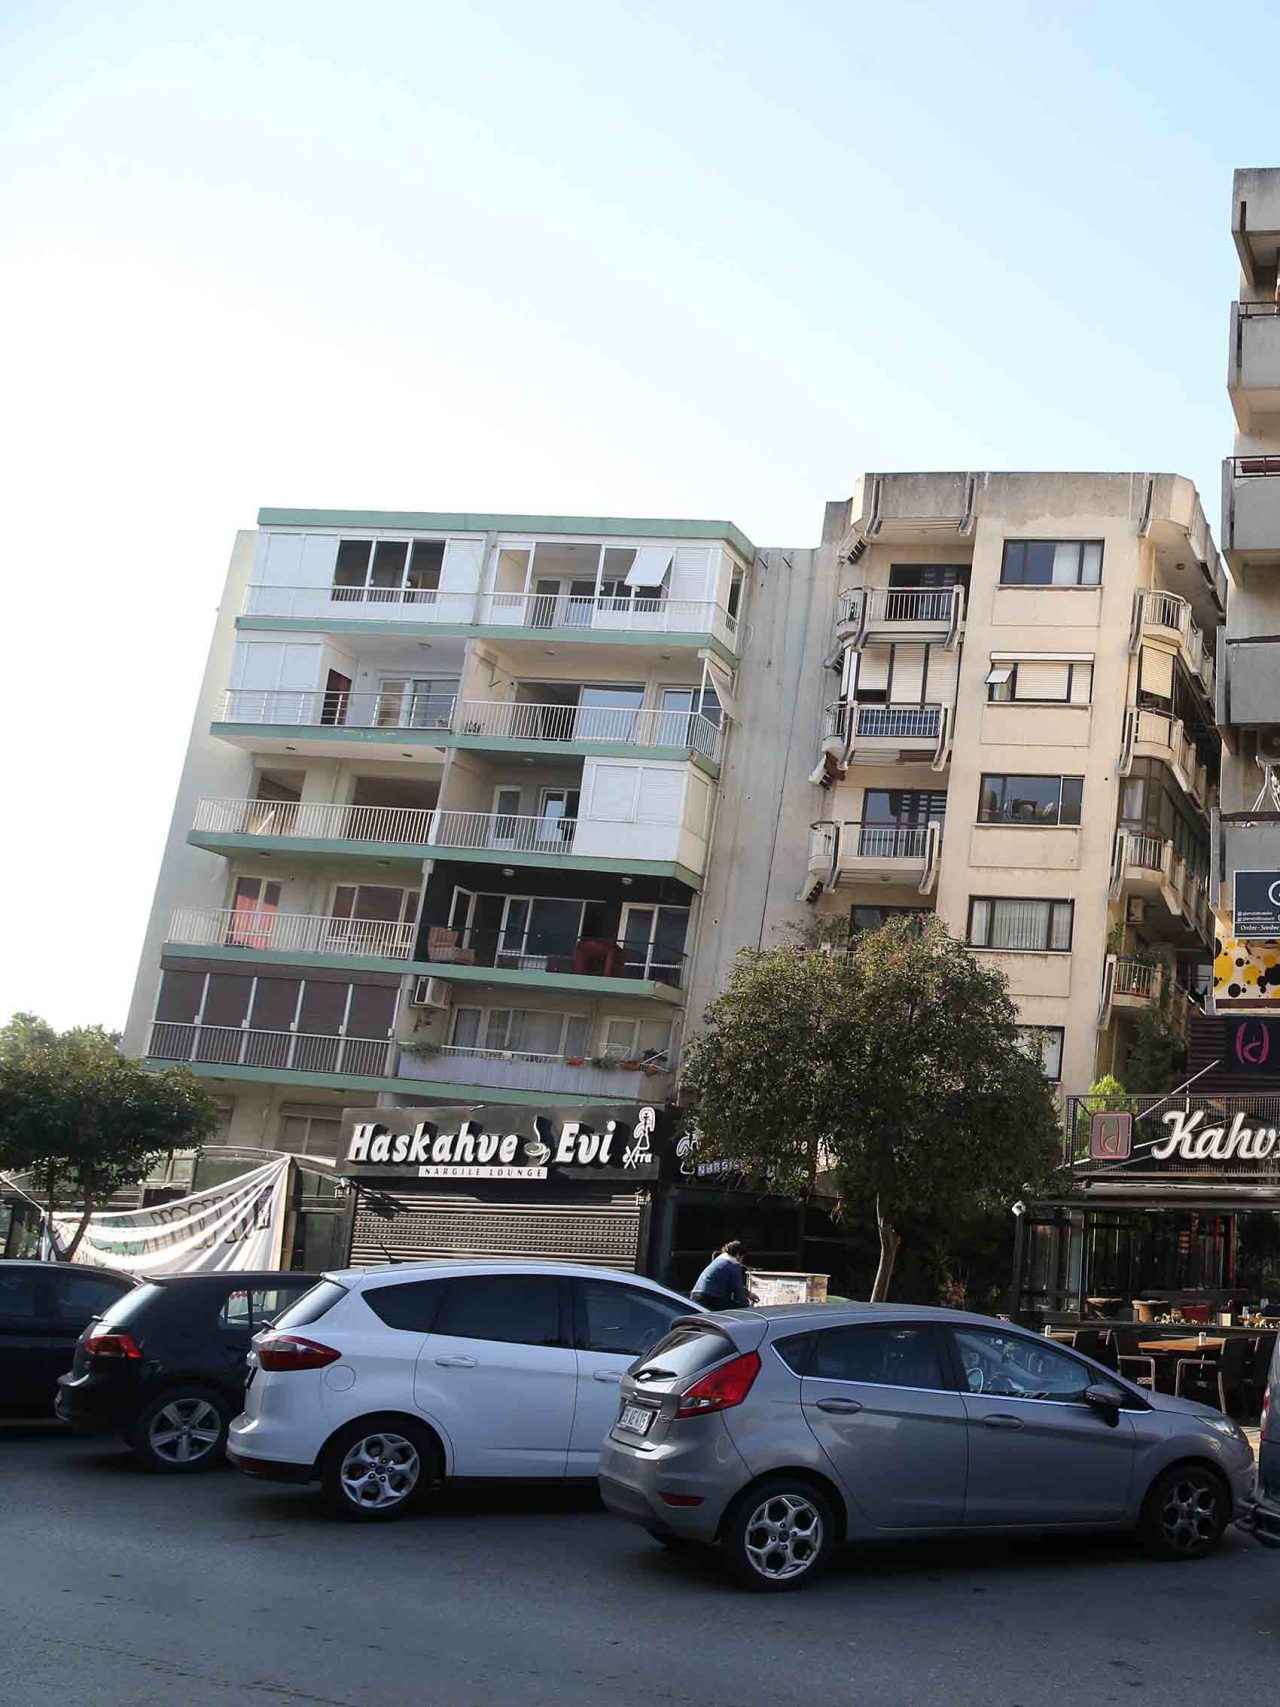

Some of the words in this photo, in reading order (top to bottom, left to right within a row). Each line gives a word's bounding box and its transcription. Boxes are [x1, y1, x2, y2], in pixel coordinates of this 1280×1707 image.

[349, 1120, 518, 1164] Haskahve
[553, 1119, 617, 1164] Evi
[489, 1168, 542, 1177] LOUNGE
